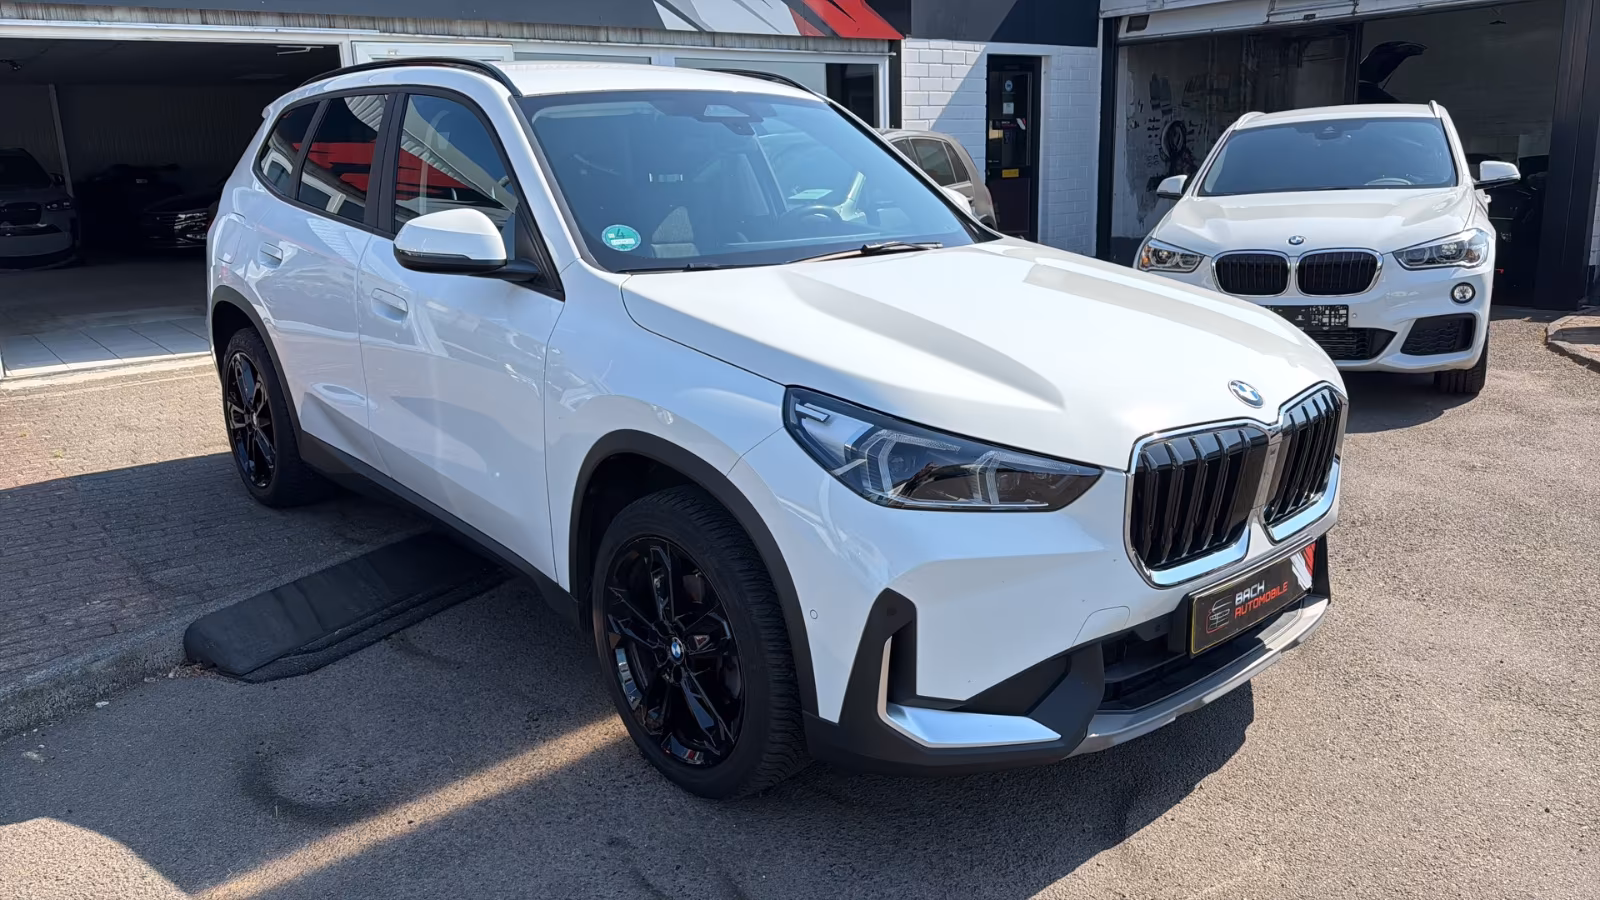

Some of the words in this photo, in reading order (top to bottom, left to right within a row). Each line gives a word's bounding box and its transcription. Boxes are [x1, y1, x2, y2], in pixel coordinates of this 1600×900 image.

[616, 228, 625, 239] 4
[1235, 581, 1265, 606] BACH
[1235, 581, 1288, 618] AUTOMOBILE
